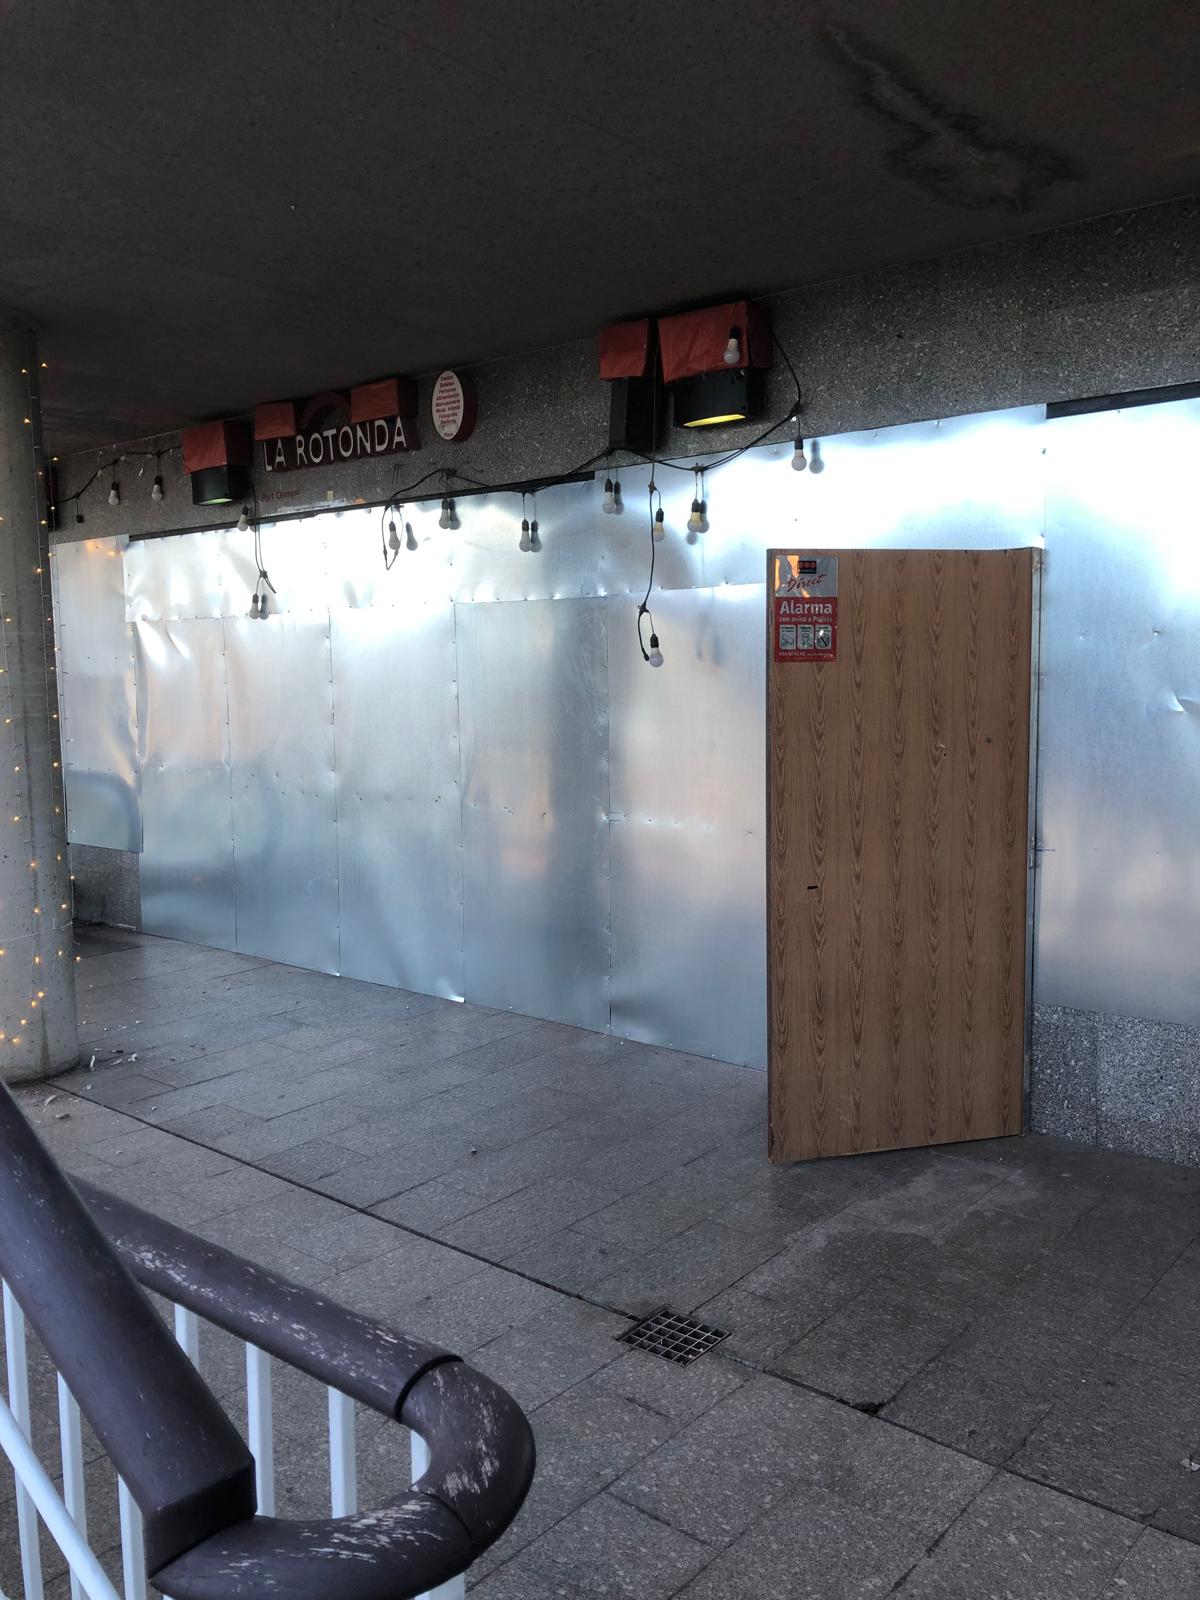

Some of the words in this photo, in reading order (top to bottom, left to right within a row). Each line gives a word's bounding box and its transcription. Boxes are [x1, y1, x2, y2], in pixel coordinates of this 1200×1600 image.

[264, 438, 286, 472] LA
[296, 415, 407, 465] ROTONDA
[787, 574, 827, 592] Direct
[780, 600, 832, 614] Alarma
